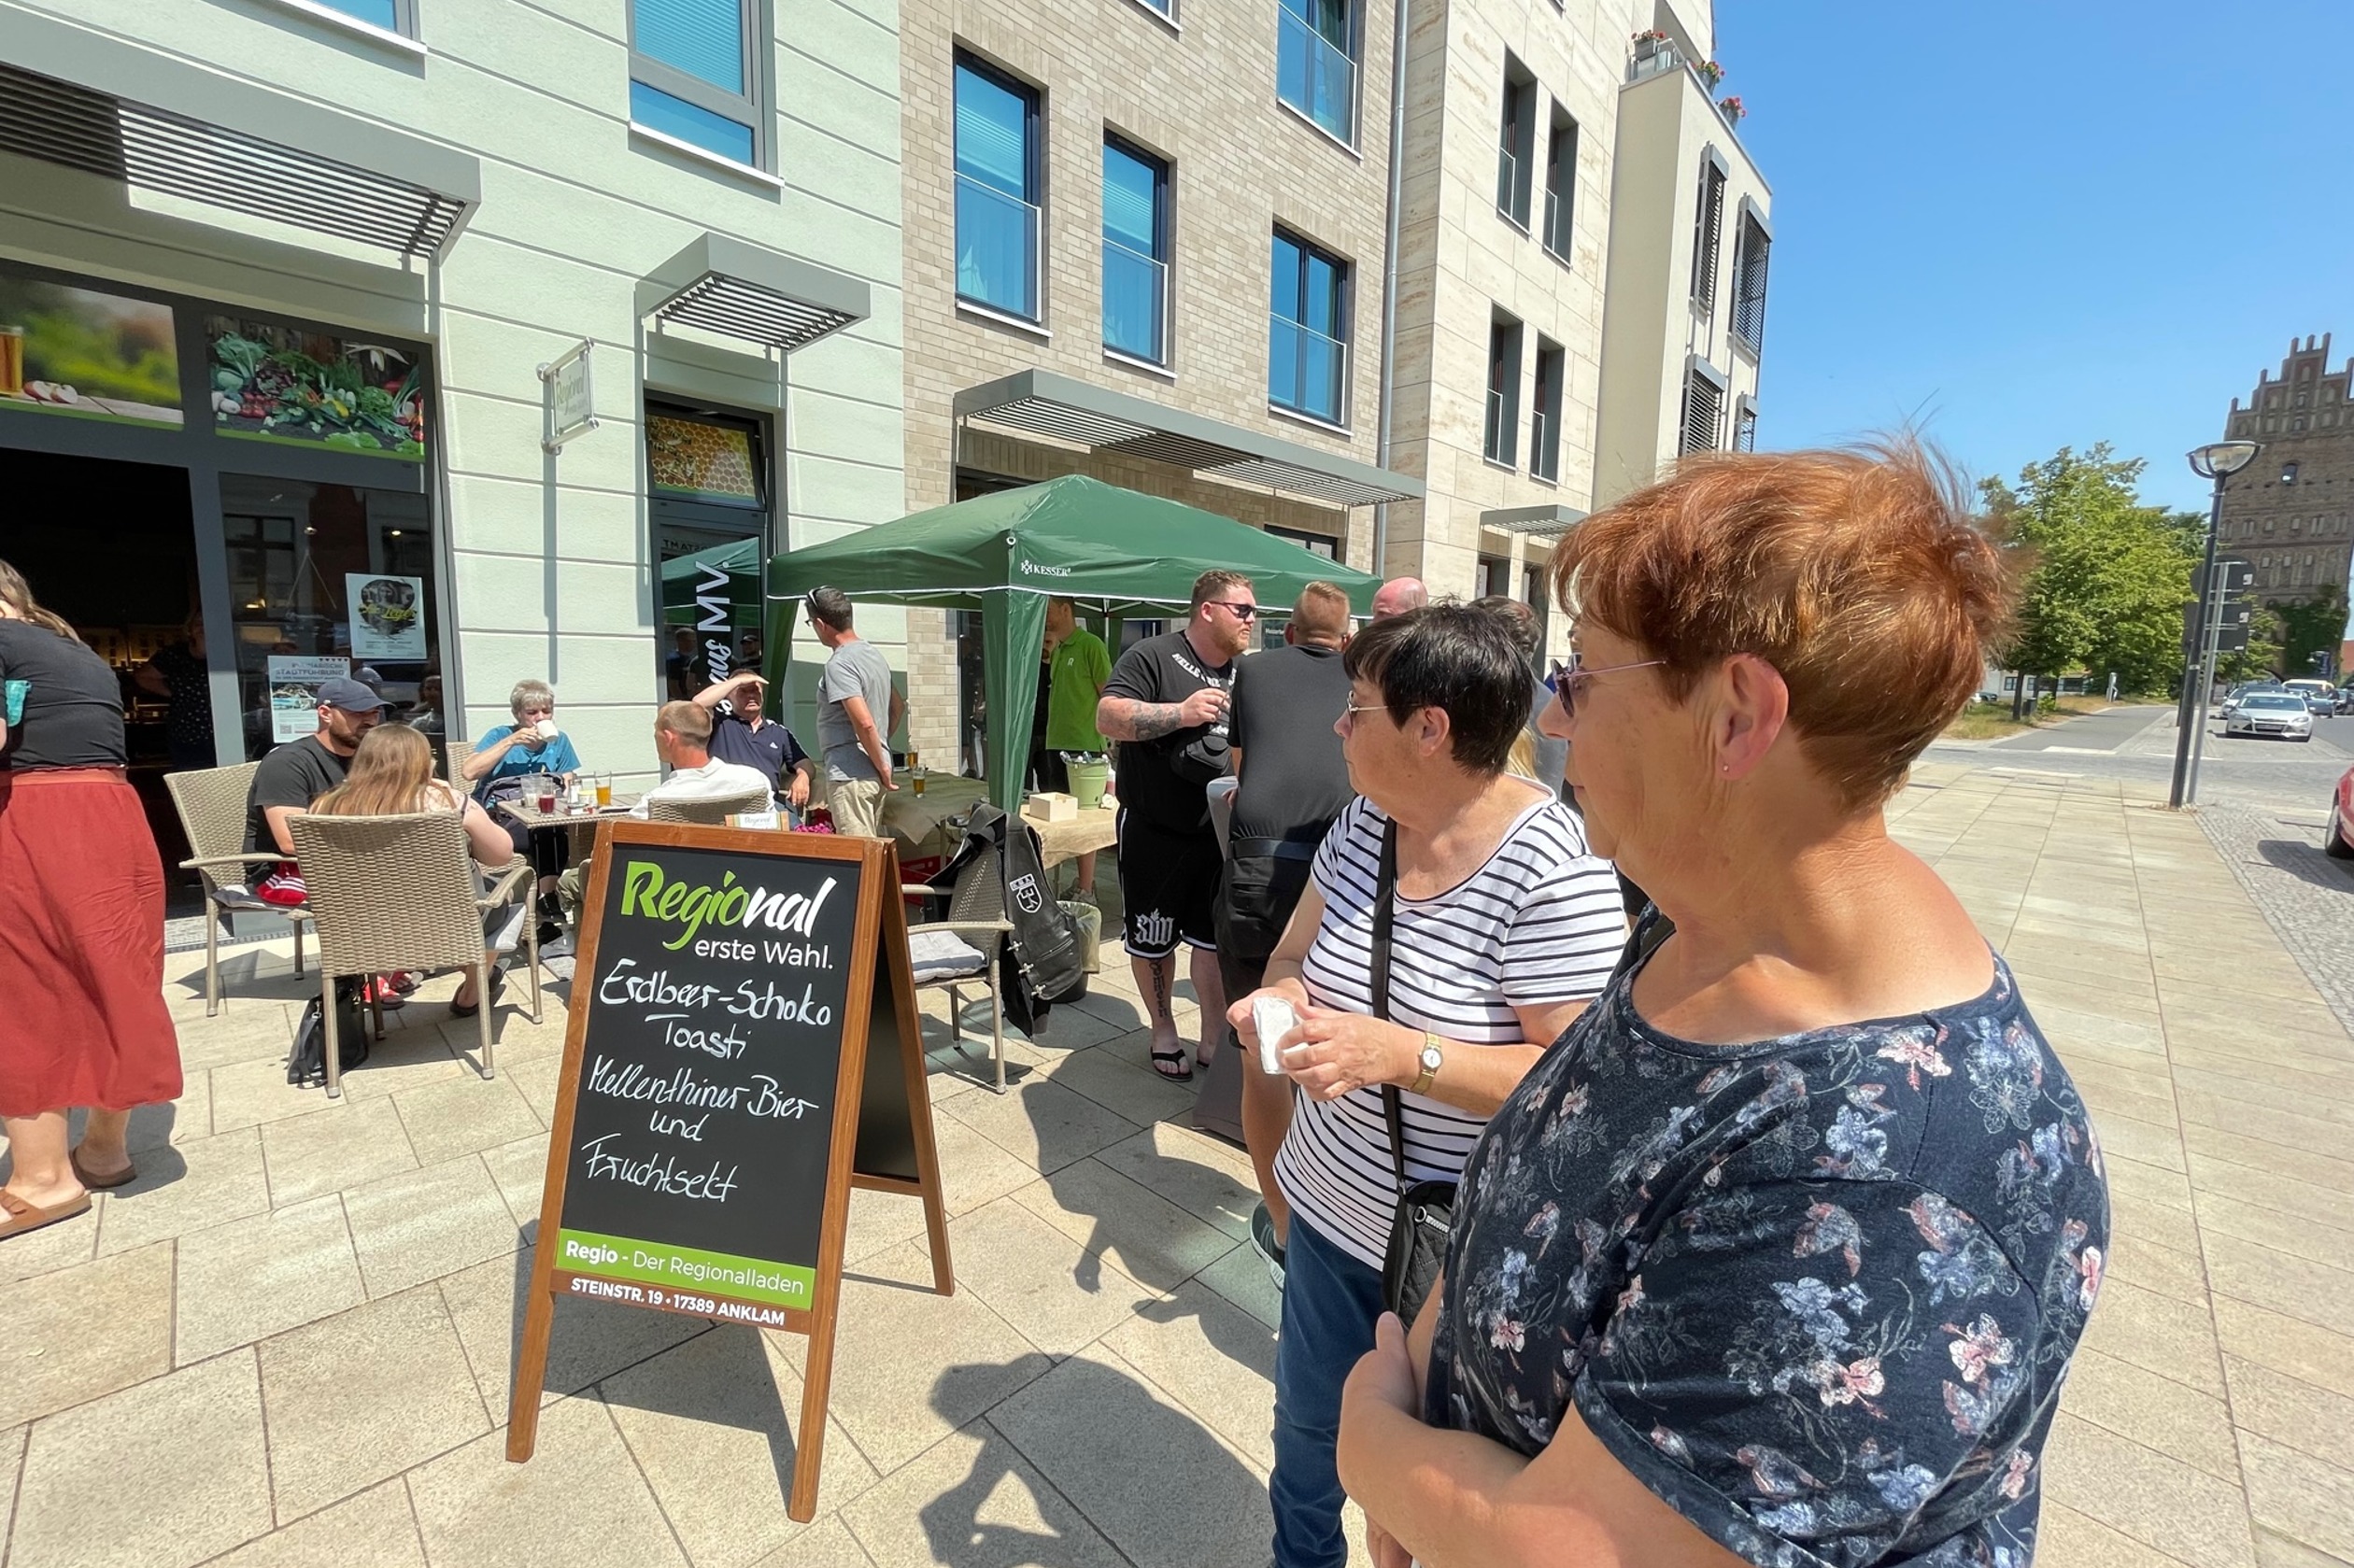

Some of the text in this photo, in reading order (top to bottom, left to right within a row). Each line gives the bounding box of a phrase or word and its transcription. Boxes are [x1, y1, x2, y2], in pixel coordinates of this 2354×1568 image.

[695, 560, 730, 632] MV.
[620, 861, 837, 950] Regional
[694, 938, 834, 969] erste Wahl.
[599, 957, 831, 1025] Erdbeer-Schoko
[588, 1054, 819, 1120] Mellenthiner Bier
[649, 1110, 709, 1141] und
[581, 1133, 738, 1202] Fruchtsekt
[565, 1239, 618, 1264] Regio
[633, 1250, 666, 1271] Der
[670, 1256, 803, 1295] Regionalladen
[571, 1278, 645, 1303] STEINSTR.
[647, 1290, 663, 1305] 19
[674, 1294, 716, 1314] 17389
[716, 1302, 786, 1326] ANKLAM
